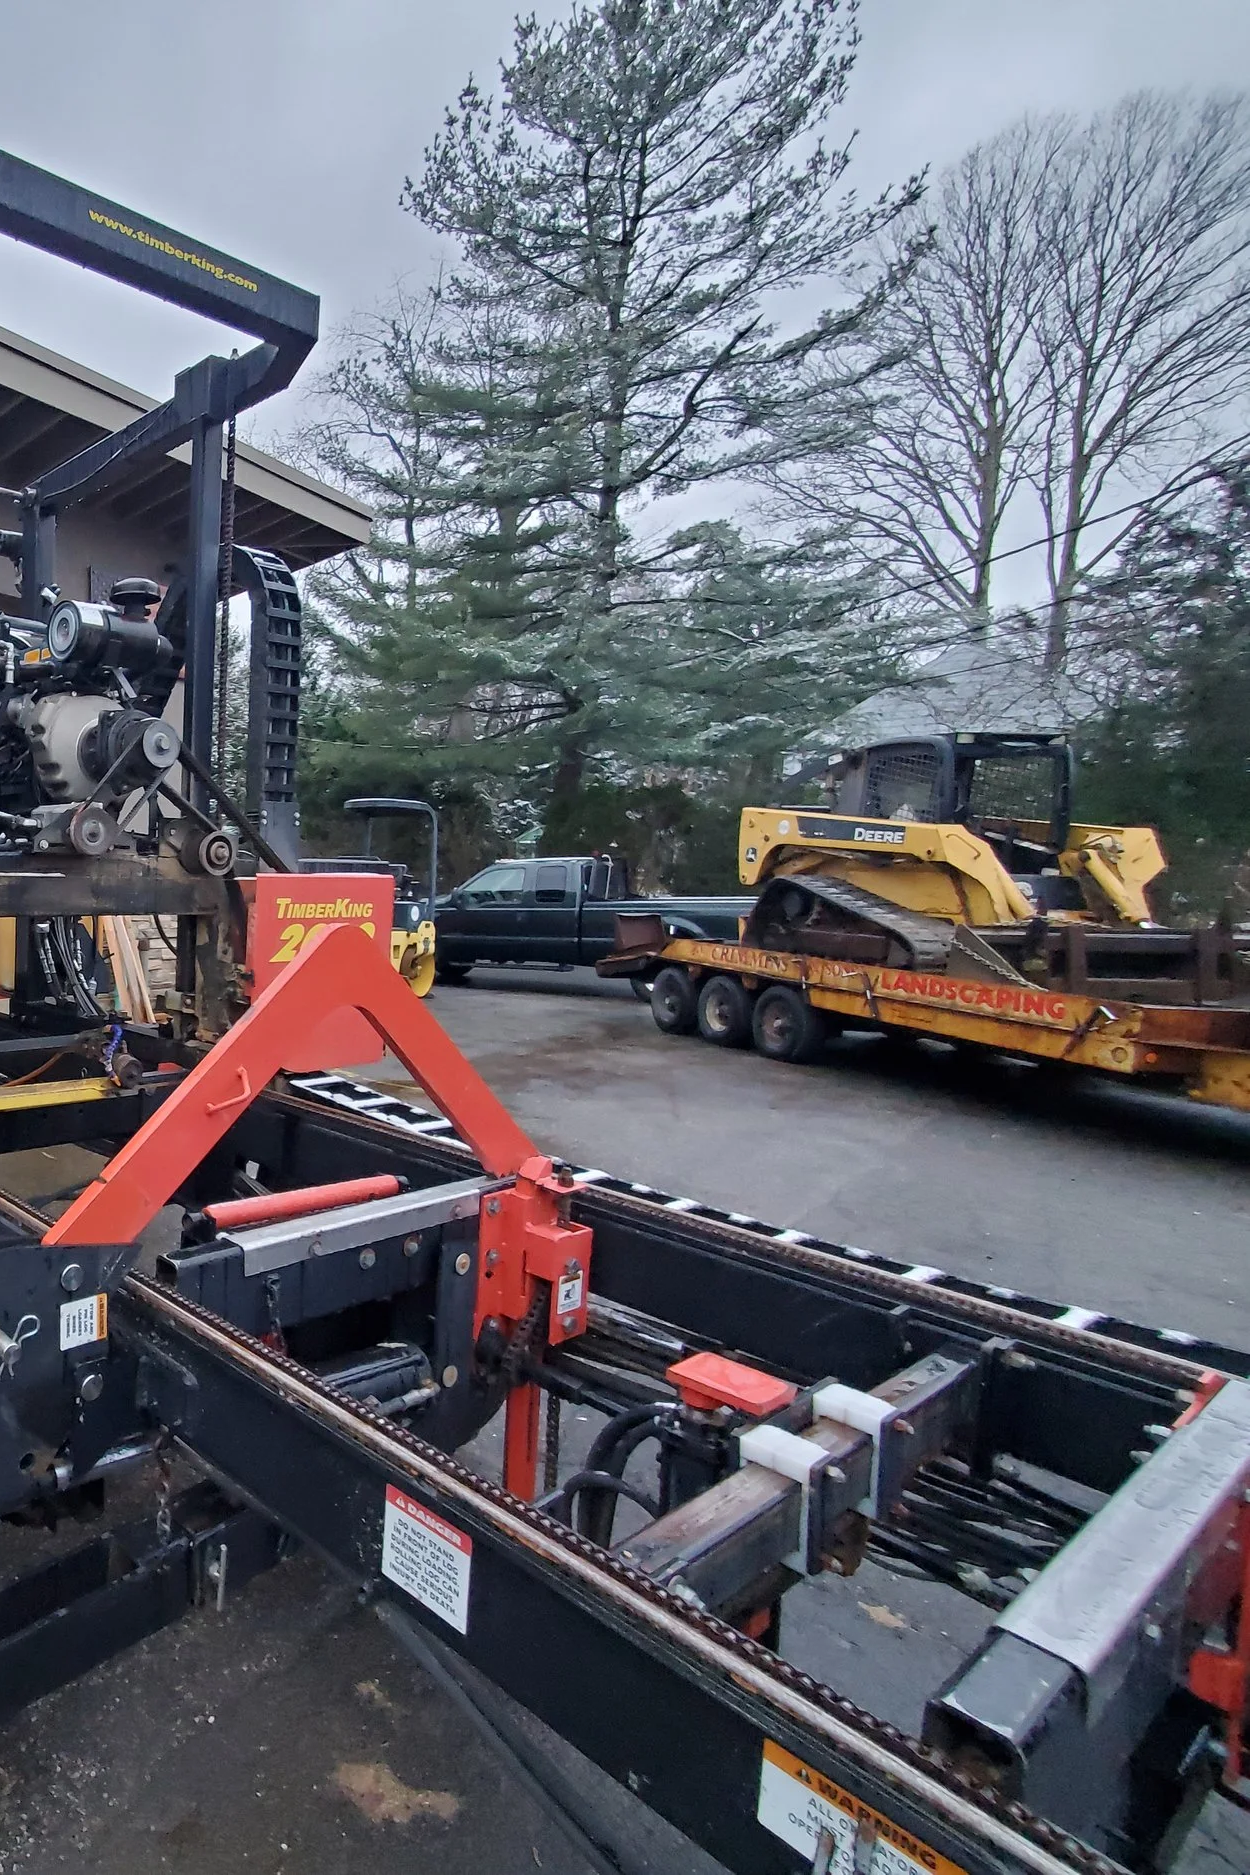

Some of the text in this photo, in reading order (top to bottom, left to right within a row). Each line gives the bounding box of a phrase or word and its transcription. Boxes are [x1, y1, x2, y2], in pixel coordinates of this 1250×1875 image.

[88, 208, 258, 293] www.timberking.com
[853, 827, 905, 844] DEERE
[881, 971, 1066, 1020] LANDSCAPING
[398, 1518, 455, 1562] DO NOT STAND
[407, 1502, 462, 1547] DANGER
[390, 1542, 421, 1571] ROLLING
[424, 1567, 440, 1583] LOG
[442, 1580, 459, 1597] CAN
[391, 1532, 460, 1588] DURING LOADING.
[394, 1525, 459, 1576] IN FRONT OF LOG
[389, 1561, 414, 1582] INJURY
[417, 1582, 428, 1595] OR
[395, 1556, 419, 1578] CAUSE
[421, 1575, 453, 1604] SERIOUS
[808, 1797, 834, 1821] ALL
[818, 1778, 938, 1870] WARNING
